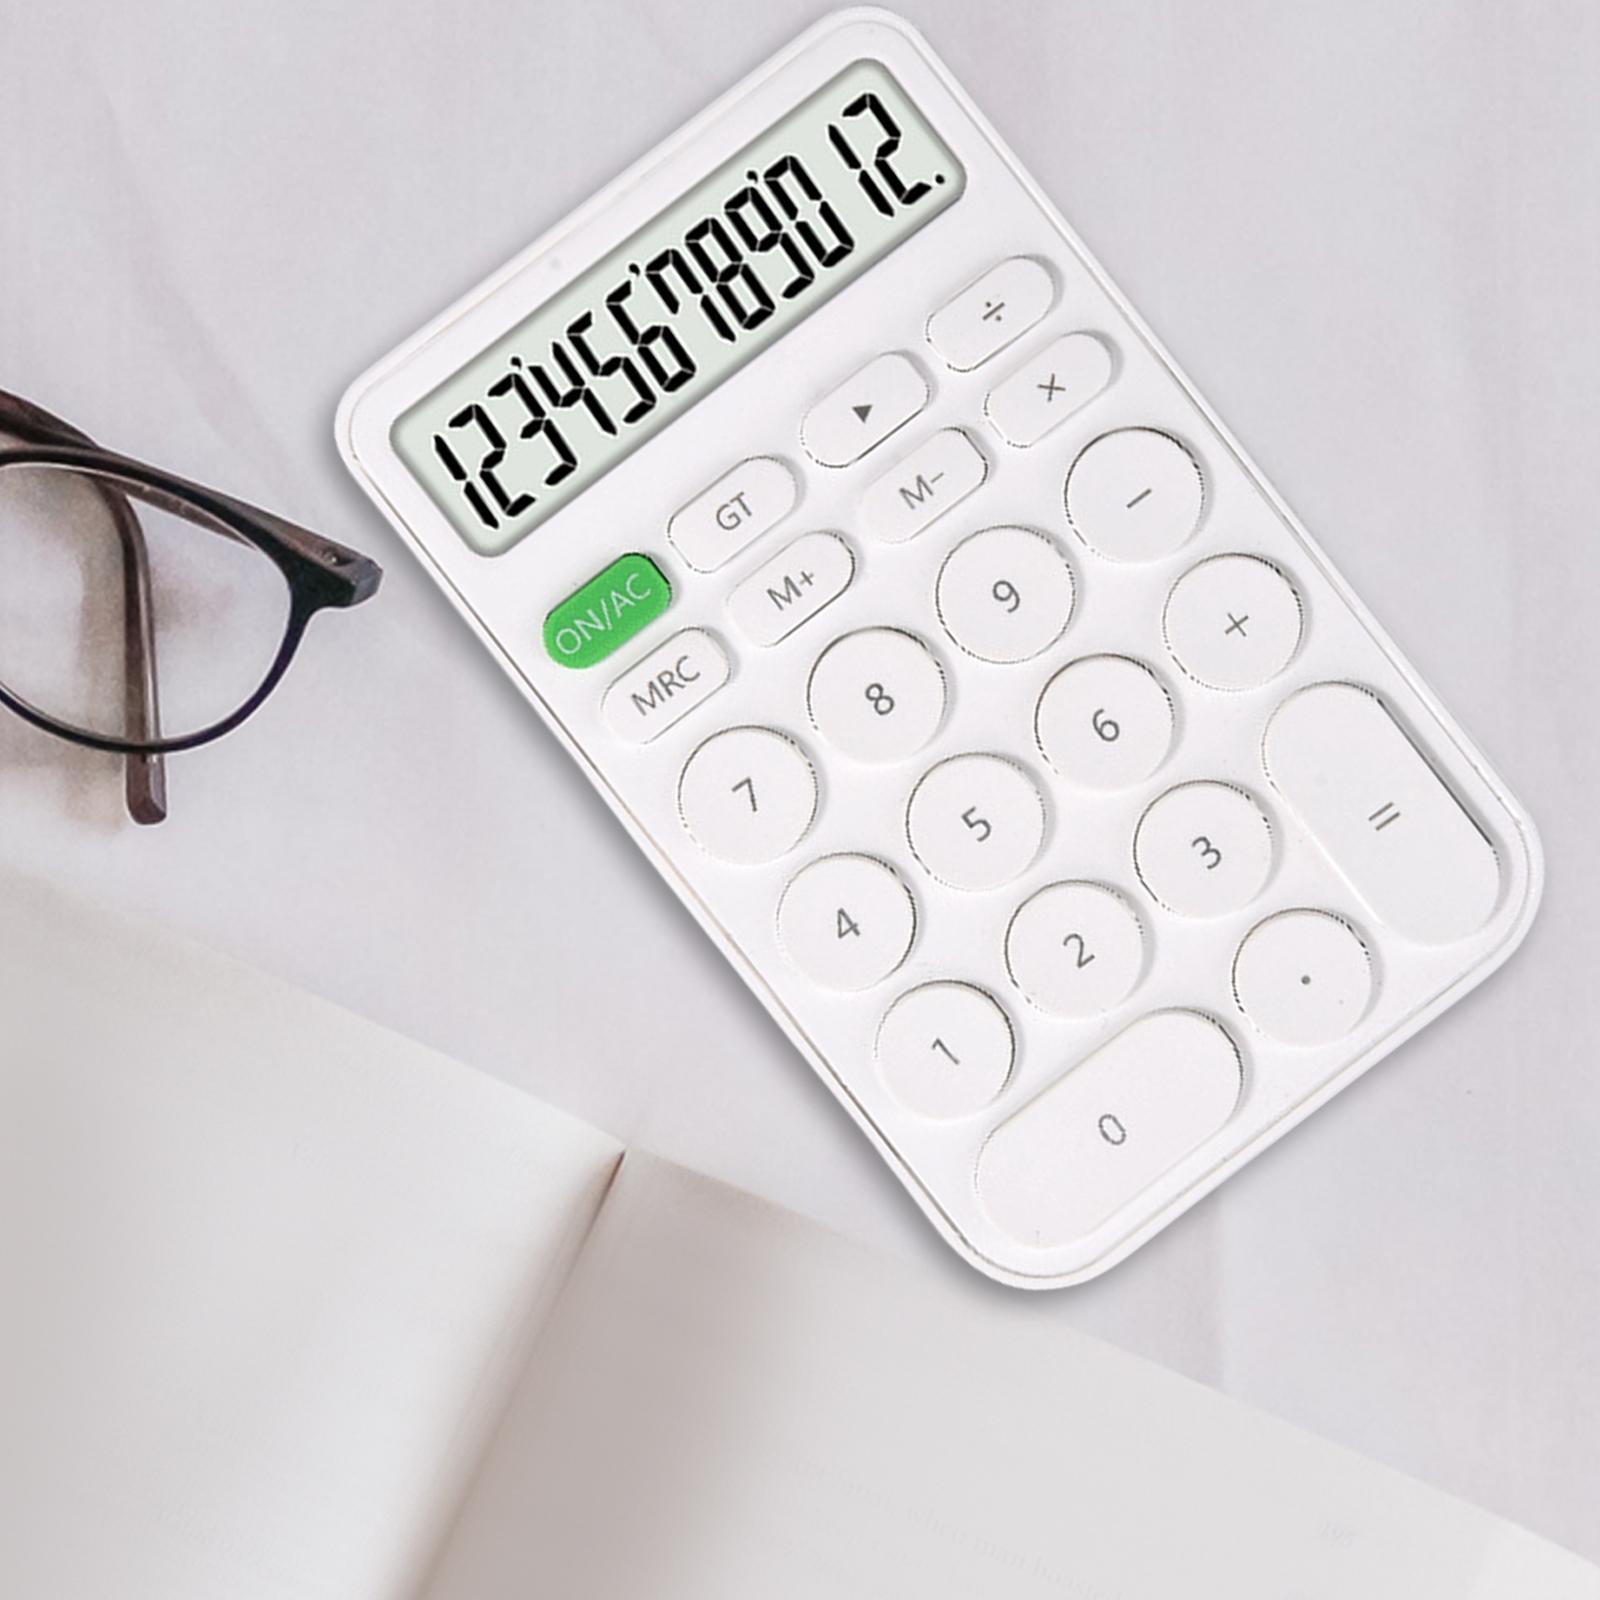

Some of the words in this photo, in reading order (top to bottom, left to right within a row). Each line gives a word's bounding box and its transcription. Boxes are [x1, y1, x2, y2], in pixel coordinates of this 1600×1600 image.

[898, 471, 945, 510] M-
[715, 491, 753, 531] GT
[766, 569, 816, 611] M+
[992, 579, 1021, 614] 9
[555, 572, 651, 655] ON/AC
[630, 655, 701, 717] MRC
[864, 682, 896, 717] 8
[1091, 707, 1121, 743] 6
[731, 776, 758, 813] 7
[961, 805, 992, 843] 5
[1191, 835, 1223, 871] 3
[836, 907, 861, 940] 4
[1062, 932, 1096, 969] 2
[931, 1037, 961, 1066] 1
[1097, 1113, 1127, 1146] 0
